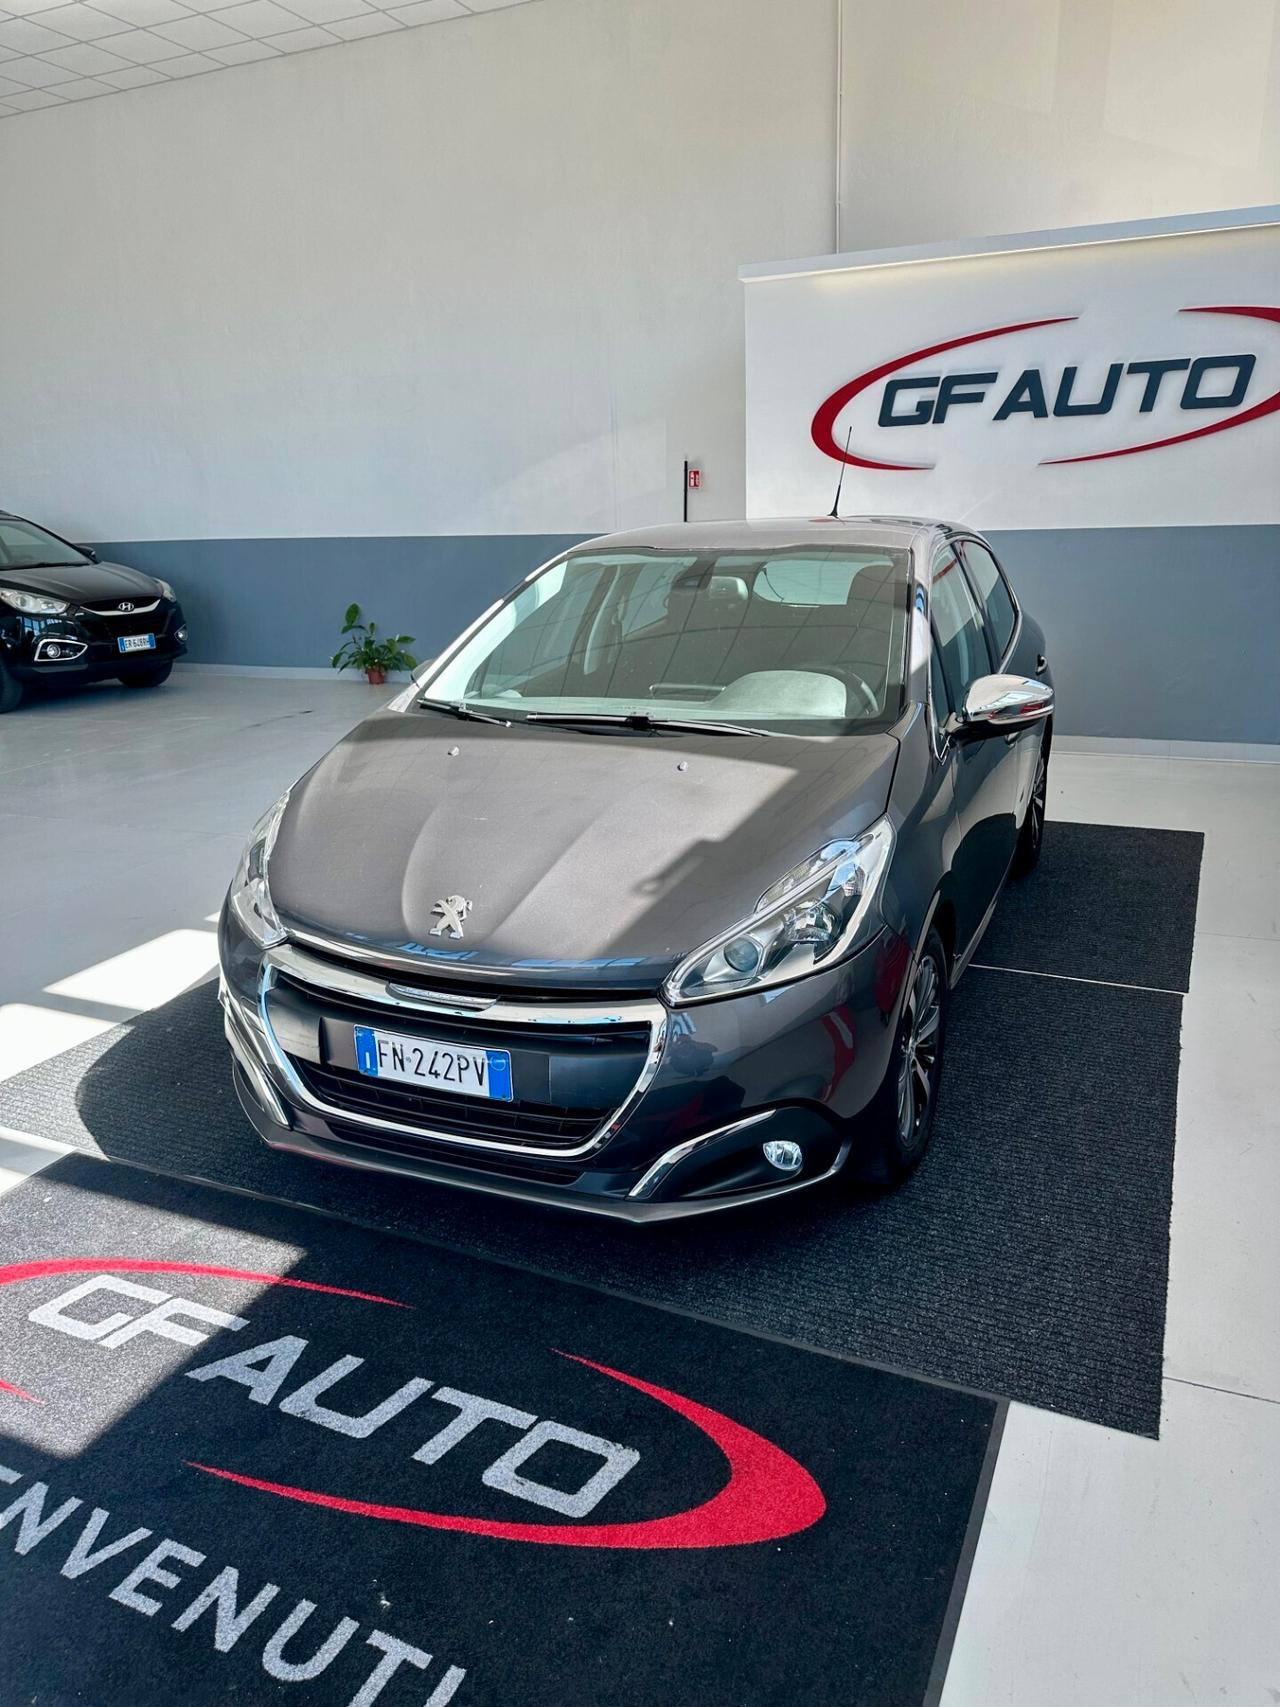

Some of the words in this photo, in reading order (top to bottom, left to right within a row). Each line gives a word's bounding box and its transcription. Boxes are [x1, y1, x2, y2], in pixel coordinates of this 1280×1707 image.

[878, 372, 998, 427] GF
[992, 354, 1256, 420] AUTO
[28, 1274, 250, 1350] GF
[185, 1335, 641, 1519] AUTO
[0, 1464, 467, 1707] NVENUTI
